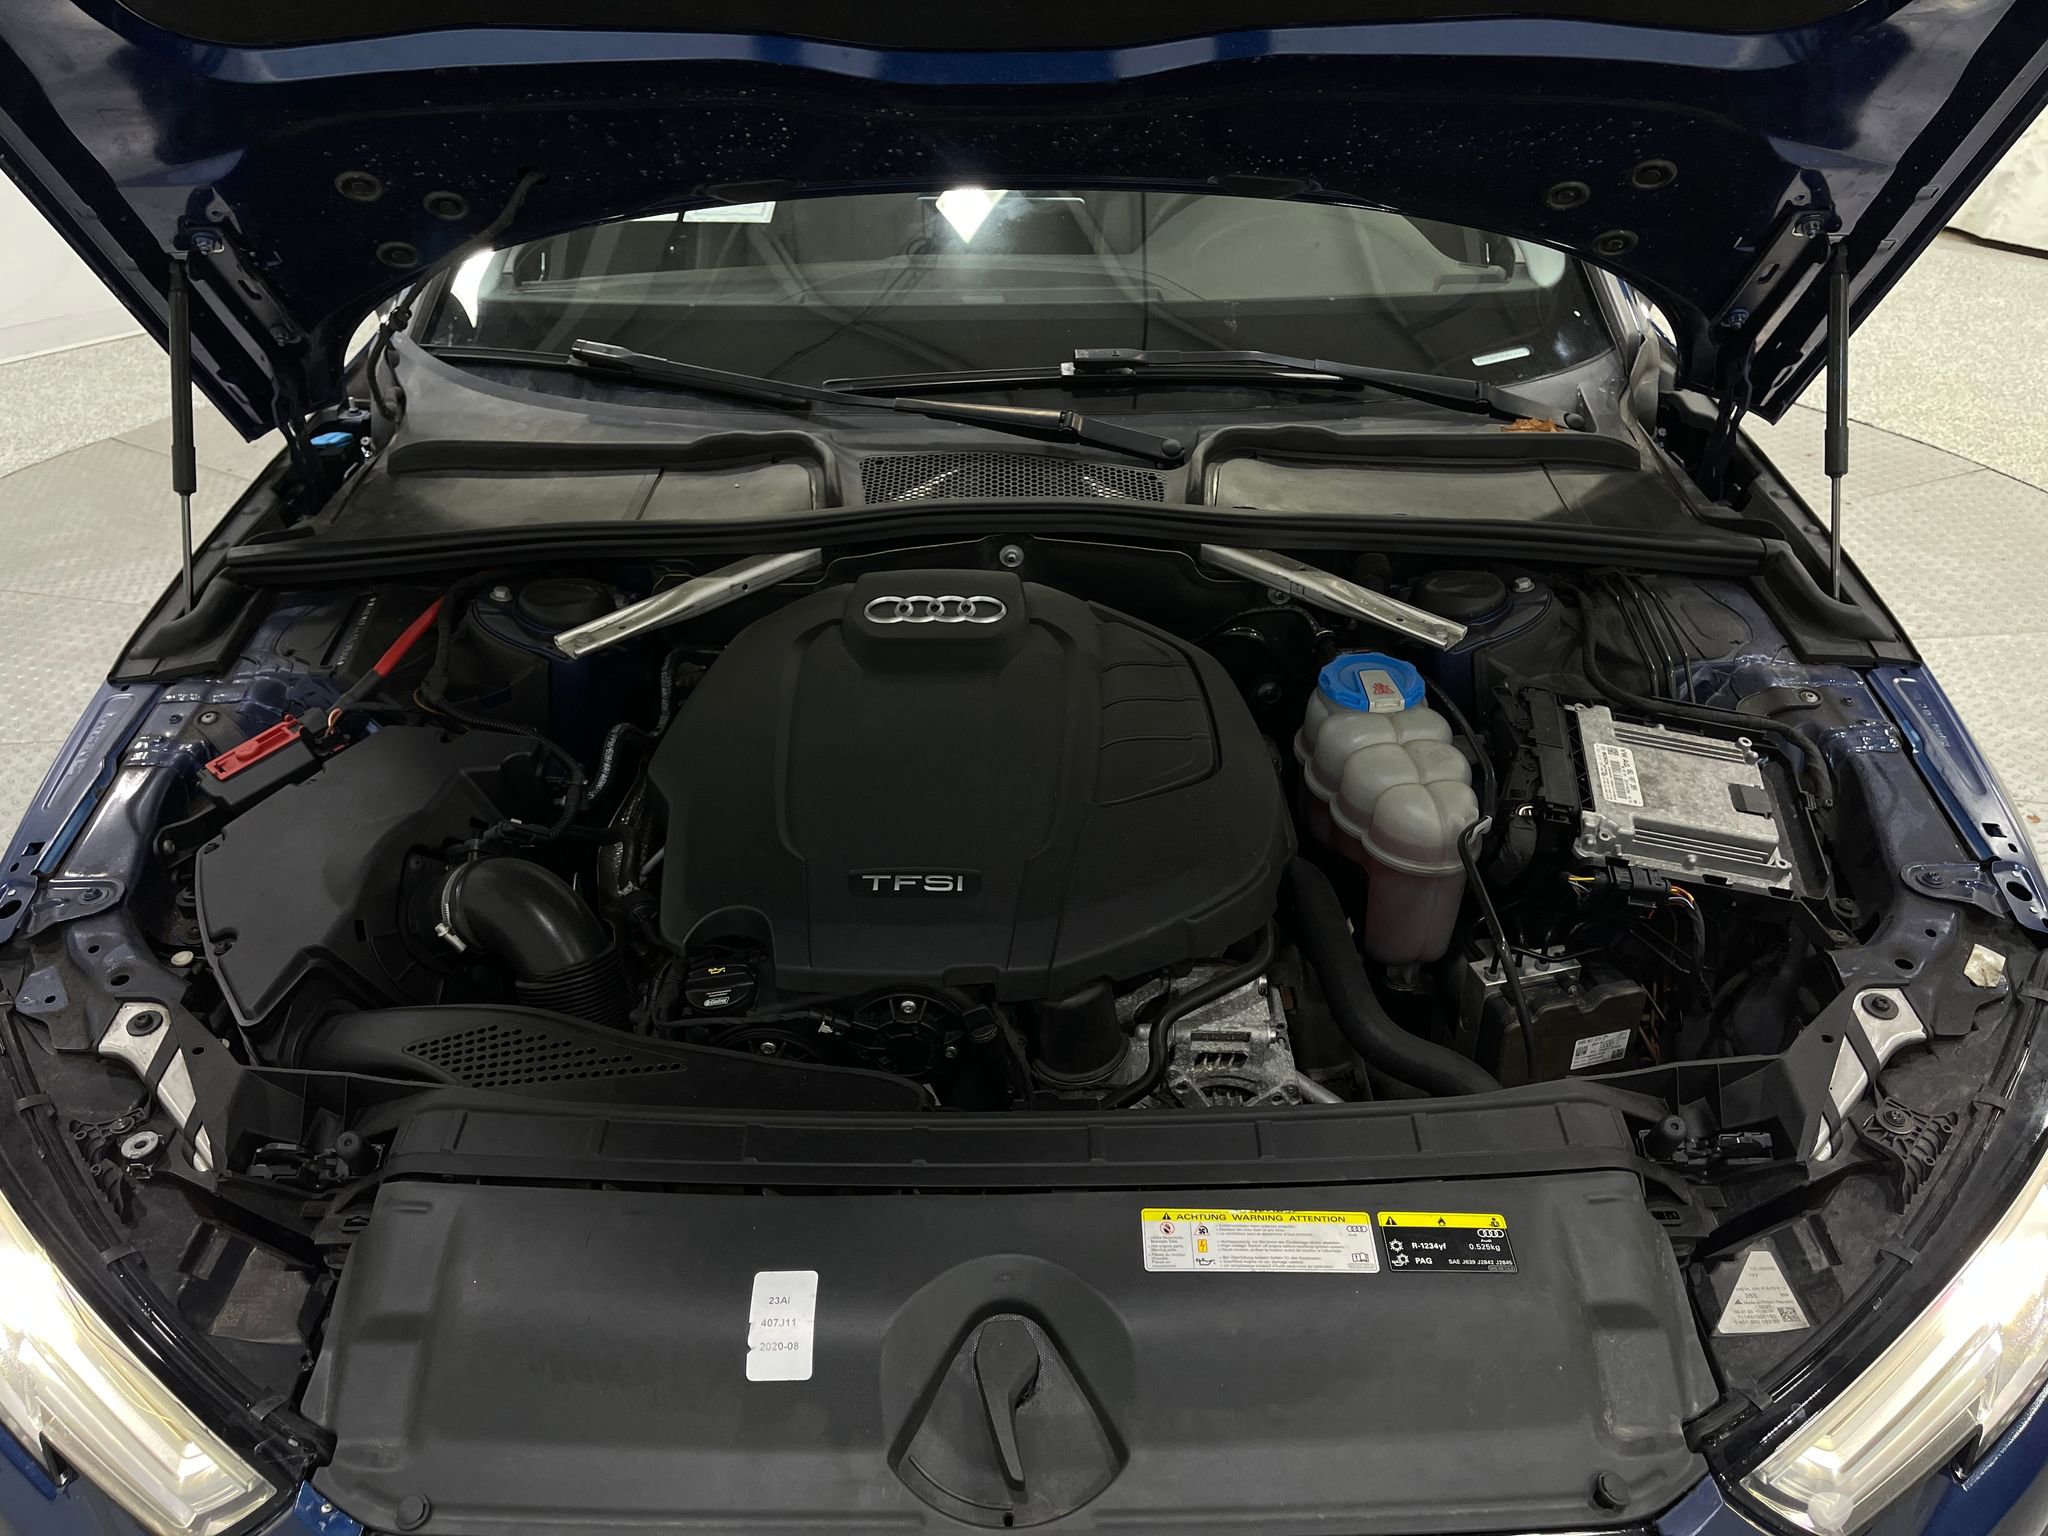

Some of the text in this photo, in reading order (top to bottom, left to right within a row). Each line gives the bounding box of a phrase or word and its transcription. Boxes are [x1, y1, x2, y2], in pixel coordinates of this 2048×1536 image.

[862, 875, 963, 891] TFSI
[1176, 1213, 1227, 1221] ACHTUNG
[1289, 1215, 1346, 1223] ATTENTION
[1411, 1242, 1501, 1252] R-1234yf 0.525kg
[1414, 1257, 1433, 1265] PAG
[760, 1318, 797, 1328] 407J11
[759, 1342, 799, 1351] 2020-08
